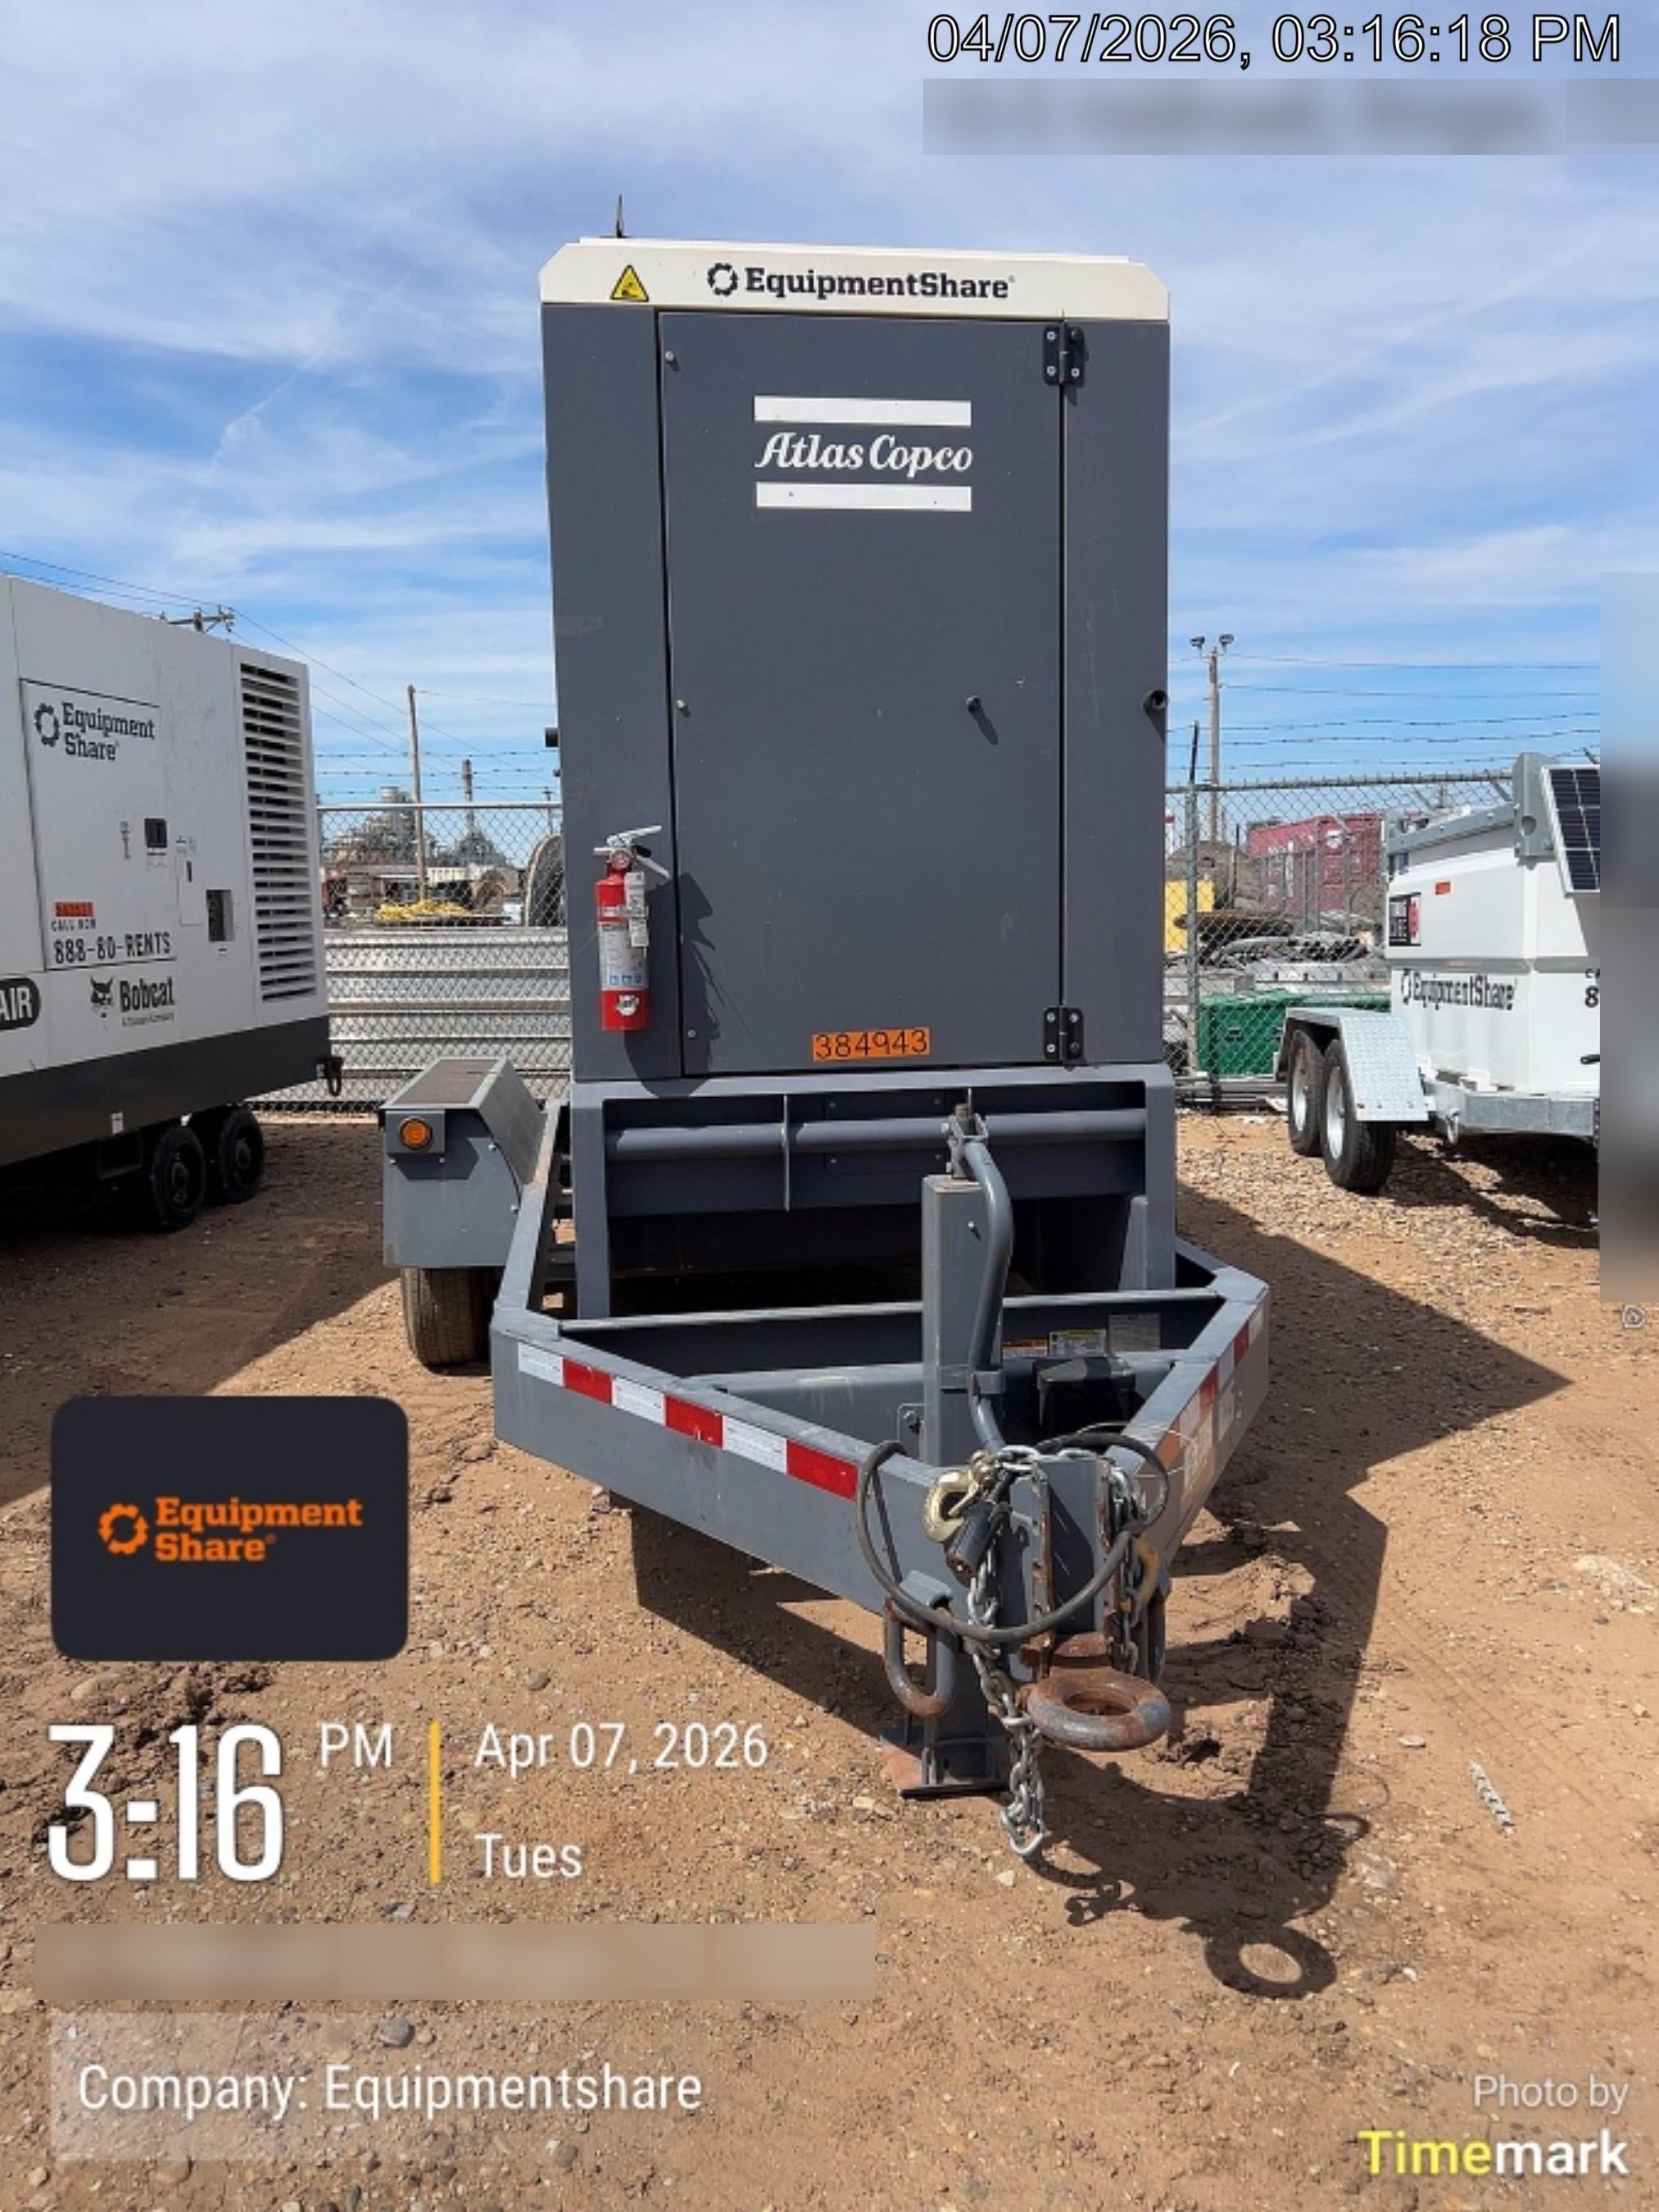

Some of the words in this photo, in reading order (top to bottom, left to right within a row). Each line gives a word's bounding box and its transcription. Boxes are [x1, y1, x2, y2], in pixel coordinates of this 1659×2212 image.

[745, 267, 1009, 300] EquipmentShare
[754, 432, 863, 469] Atlas
[869, 434, 973, 478] Copco
[61, 701, 155, 740] Equipment
[65, 732, 116, 761] Share
[53, 931, 170, 964] 888-80-RENTS
[120, 977, 175, 1013] Bobcat
[1413, 972, 1514, 1011] EquipmentShare
[815, 1029, 927, 1057] 384943
